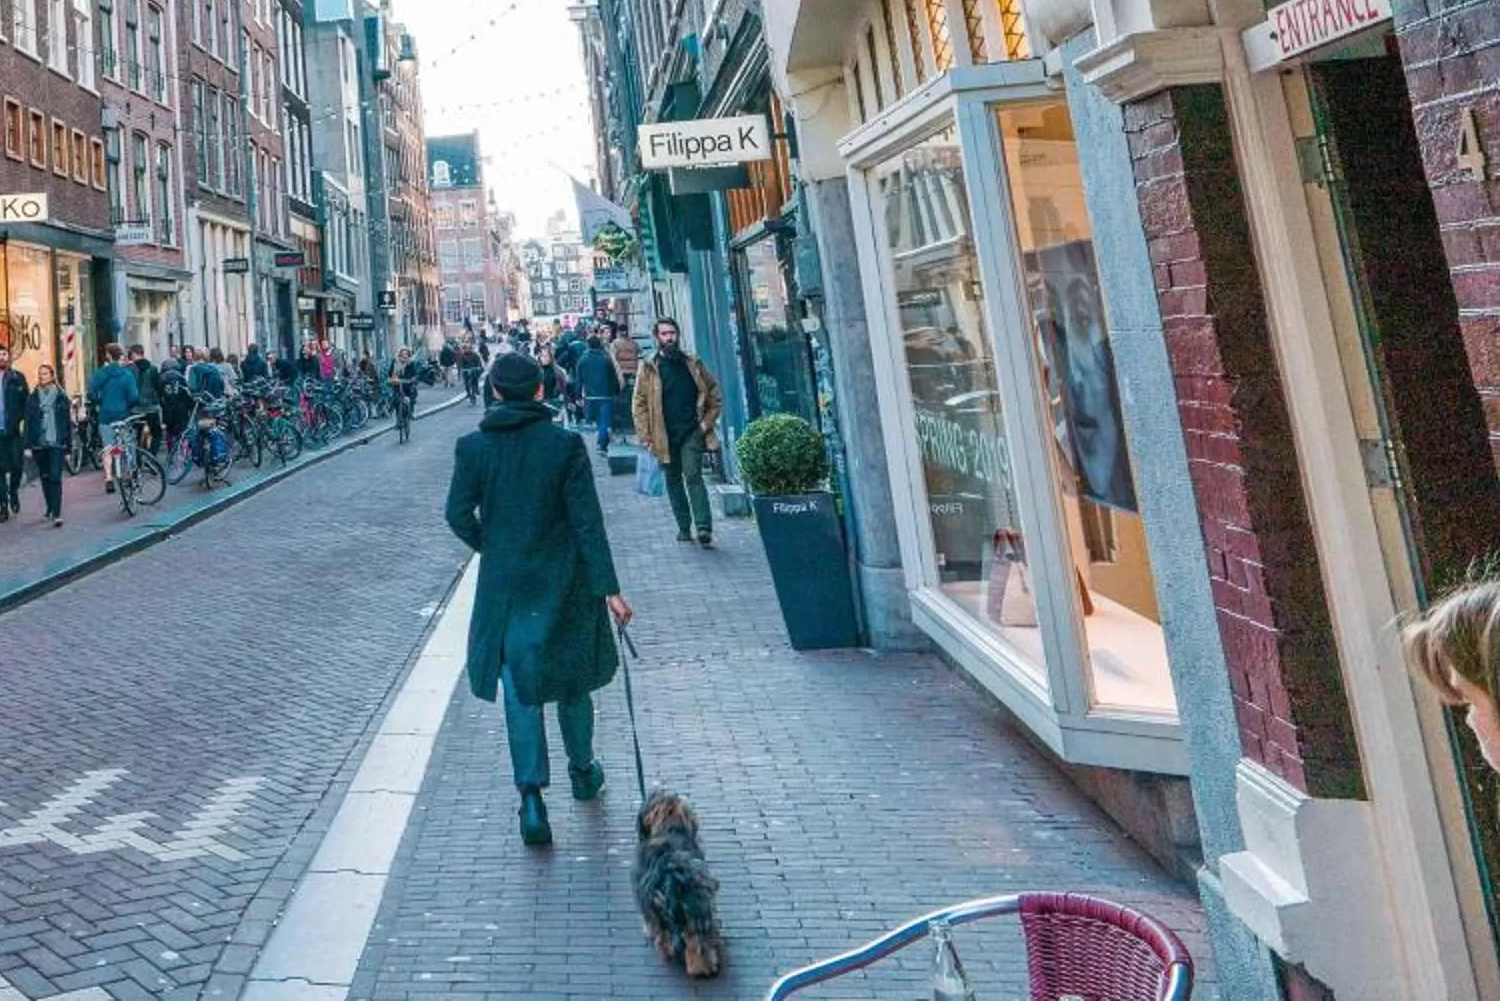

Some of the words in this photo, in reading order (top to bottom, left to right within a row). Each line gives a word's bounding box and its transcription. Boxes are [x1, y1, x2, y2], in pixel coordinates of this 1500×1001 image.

[649, 130, 733, 160] Filippa
[737, 125, 759, 150] K
[1457, 106, 1486, 182] 4
[915, 412, 968, 473] PRING
[809, 500, 818, 511] K
